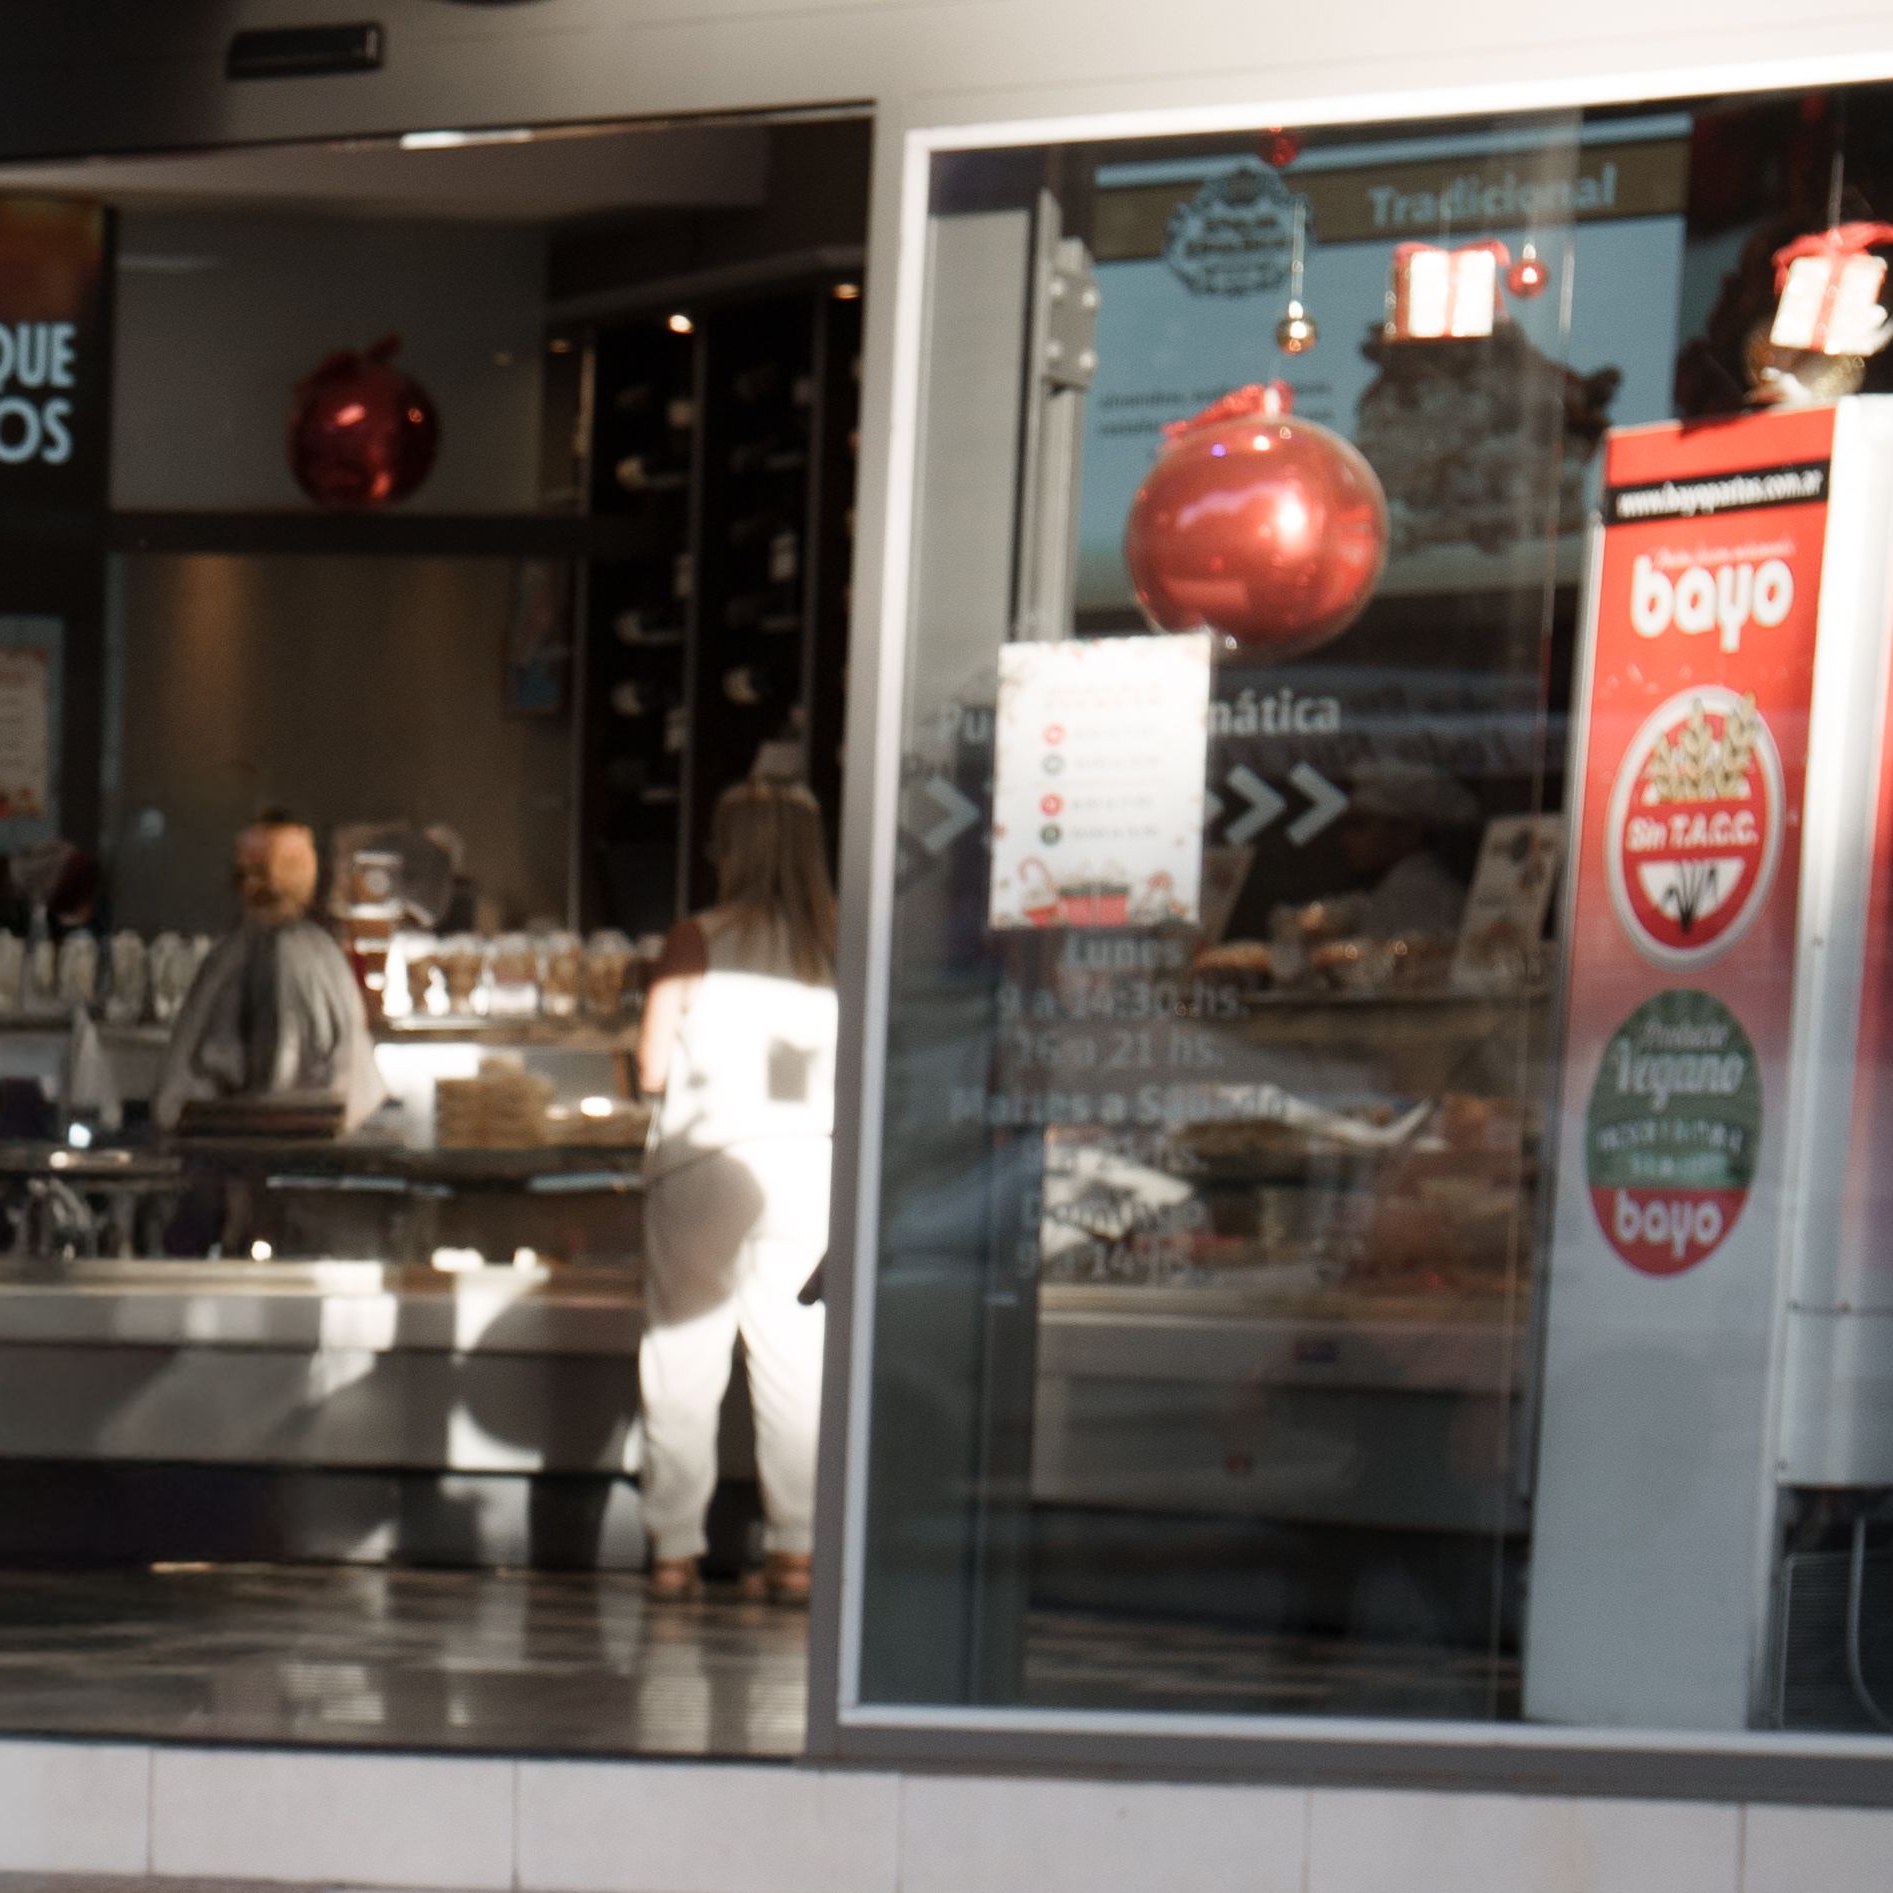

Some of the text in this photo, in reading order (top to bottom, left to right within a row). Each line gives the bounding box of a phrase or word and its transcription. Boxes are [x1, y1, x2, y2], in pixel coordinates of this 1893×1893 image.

[1631, 555, 1795, 654] bayo
[1063, 933, 1183, 970] Lunes
[1616, 1188, 1723, 1259] bayo
